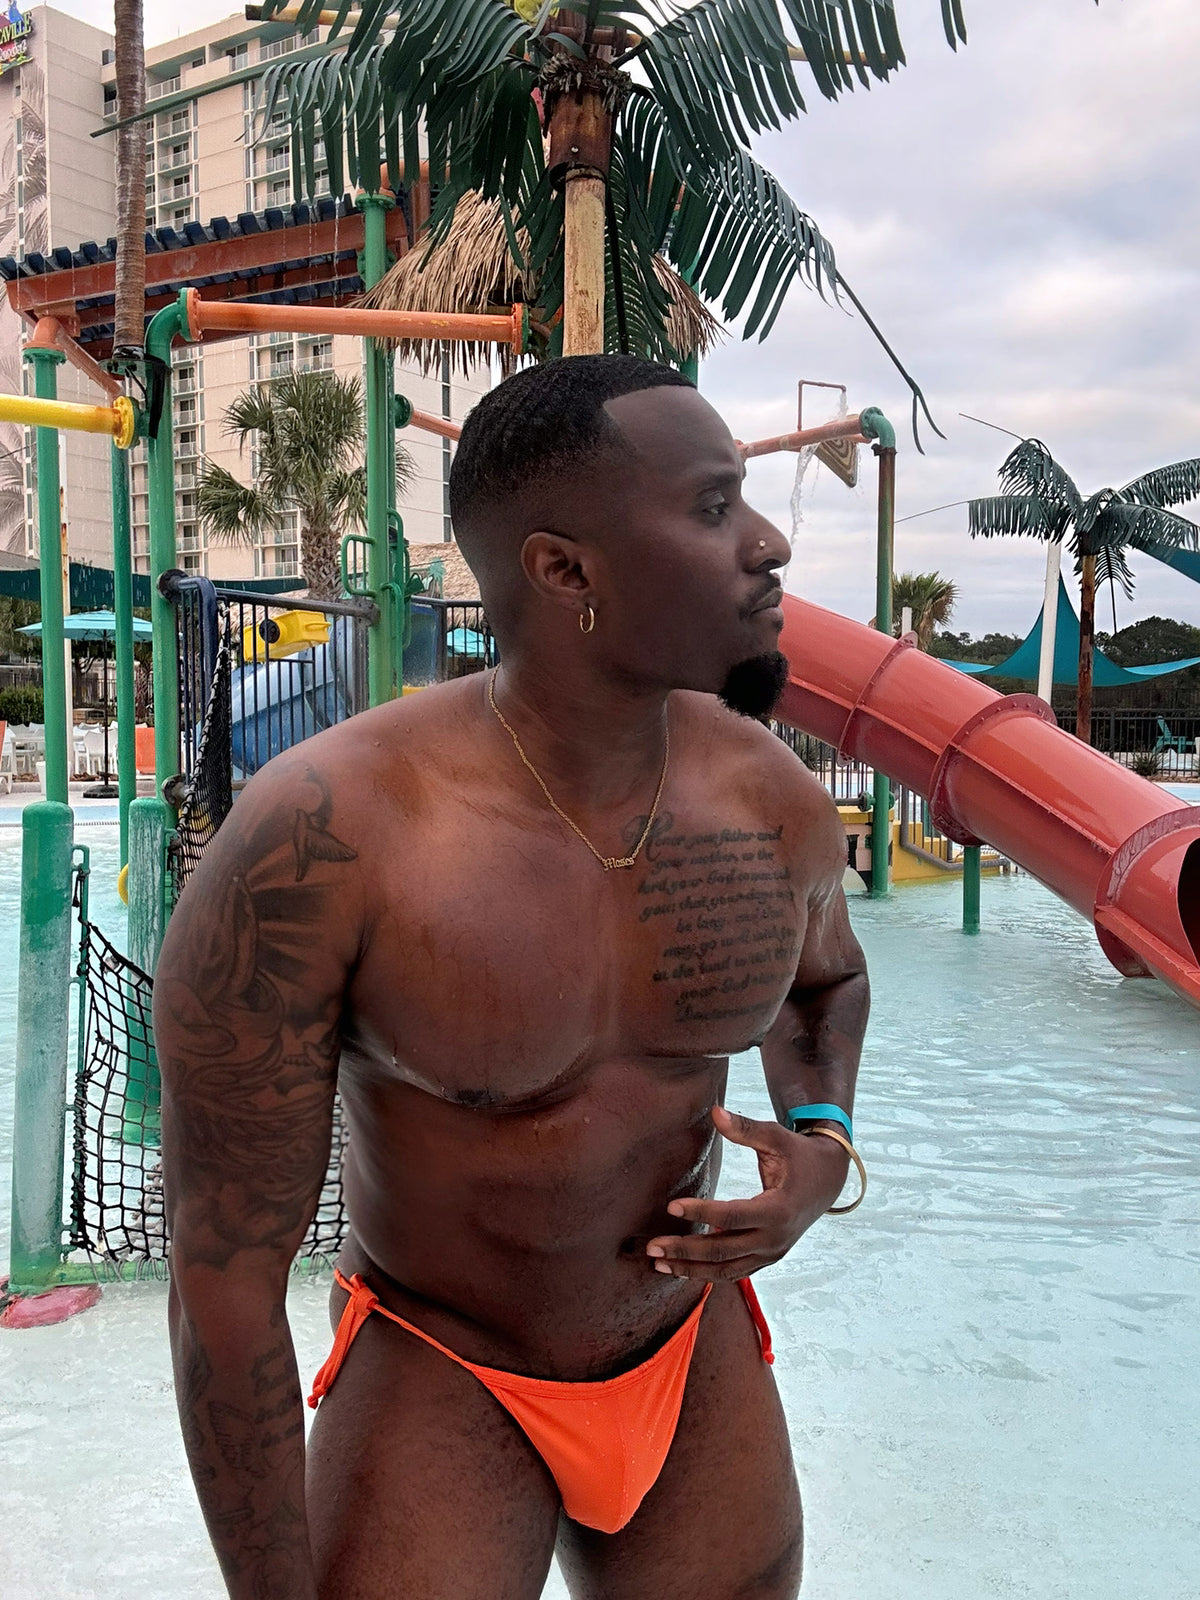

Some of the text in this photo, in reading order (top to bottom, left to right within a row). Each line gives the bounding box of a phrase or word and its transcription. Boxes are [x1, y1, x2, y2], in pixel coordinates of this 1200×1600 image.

[0, 11, 32, 45] AVILLE
[757, 825, 783, 841] and
[757, 848, 774, 861] the
